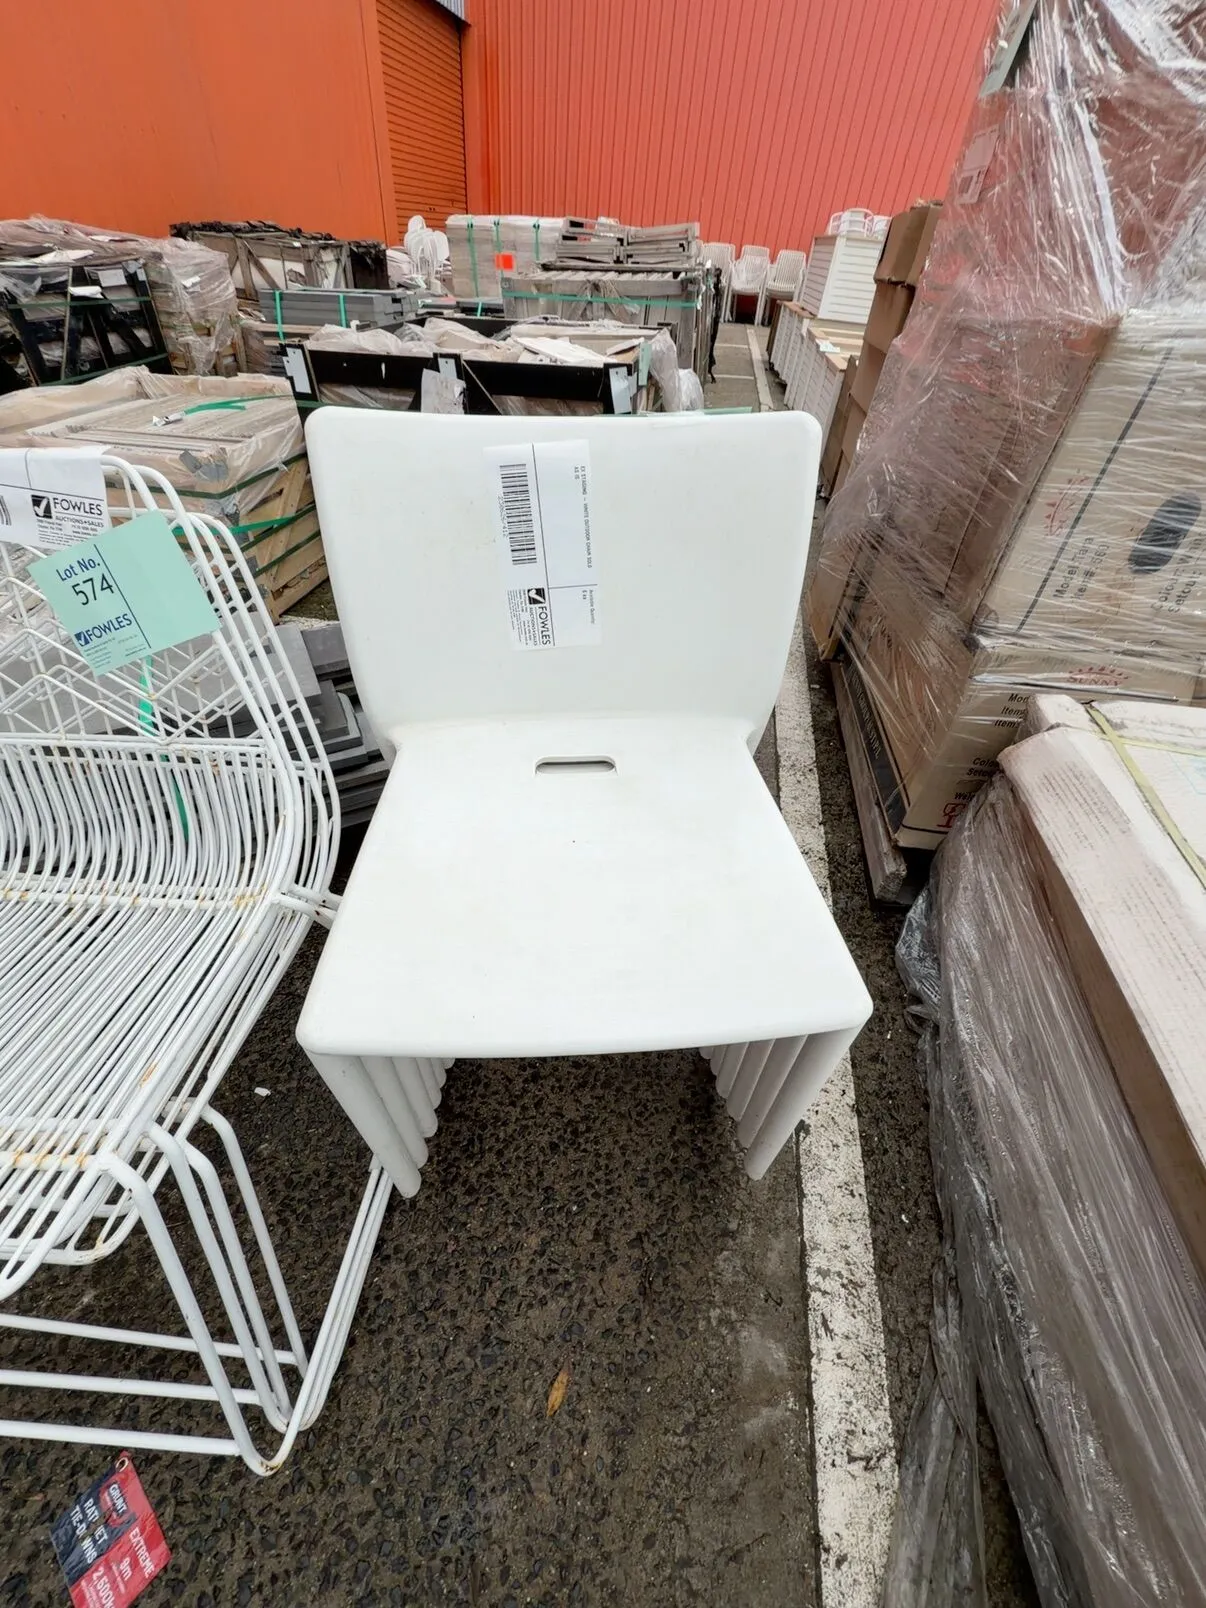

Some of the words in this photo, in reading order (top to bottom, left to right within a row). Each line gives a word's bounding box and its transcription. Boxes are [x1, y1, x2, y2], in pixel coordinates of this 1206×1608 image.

[53, 497, 103, 516] FOWLES
[56, 563, 78, 581] Lot
[77, 558, 100, 573] No.
[72, 573, 114, 606] 574
[85, 613, 133, 642] FOWLES
[538, 606, 551, 646] FOWLES
[1067, 675, 1122, 687] SUNNY
[109, 1484, 127, 1514] GRUNT
[84, 1498, 108, 1544] RATET
[129, 1527, 155, 1579] EXTREME
